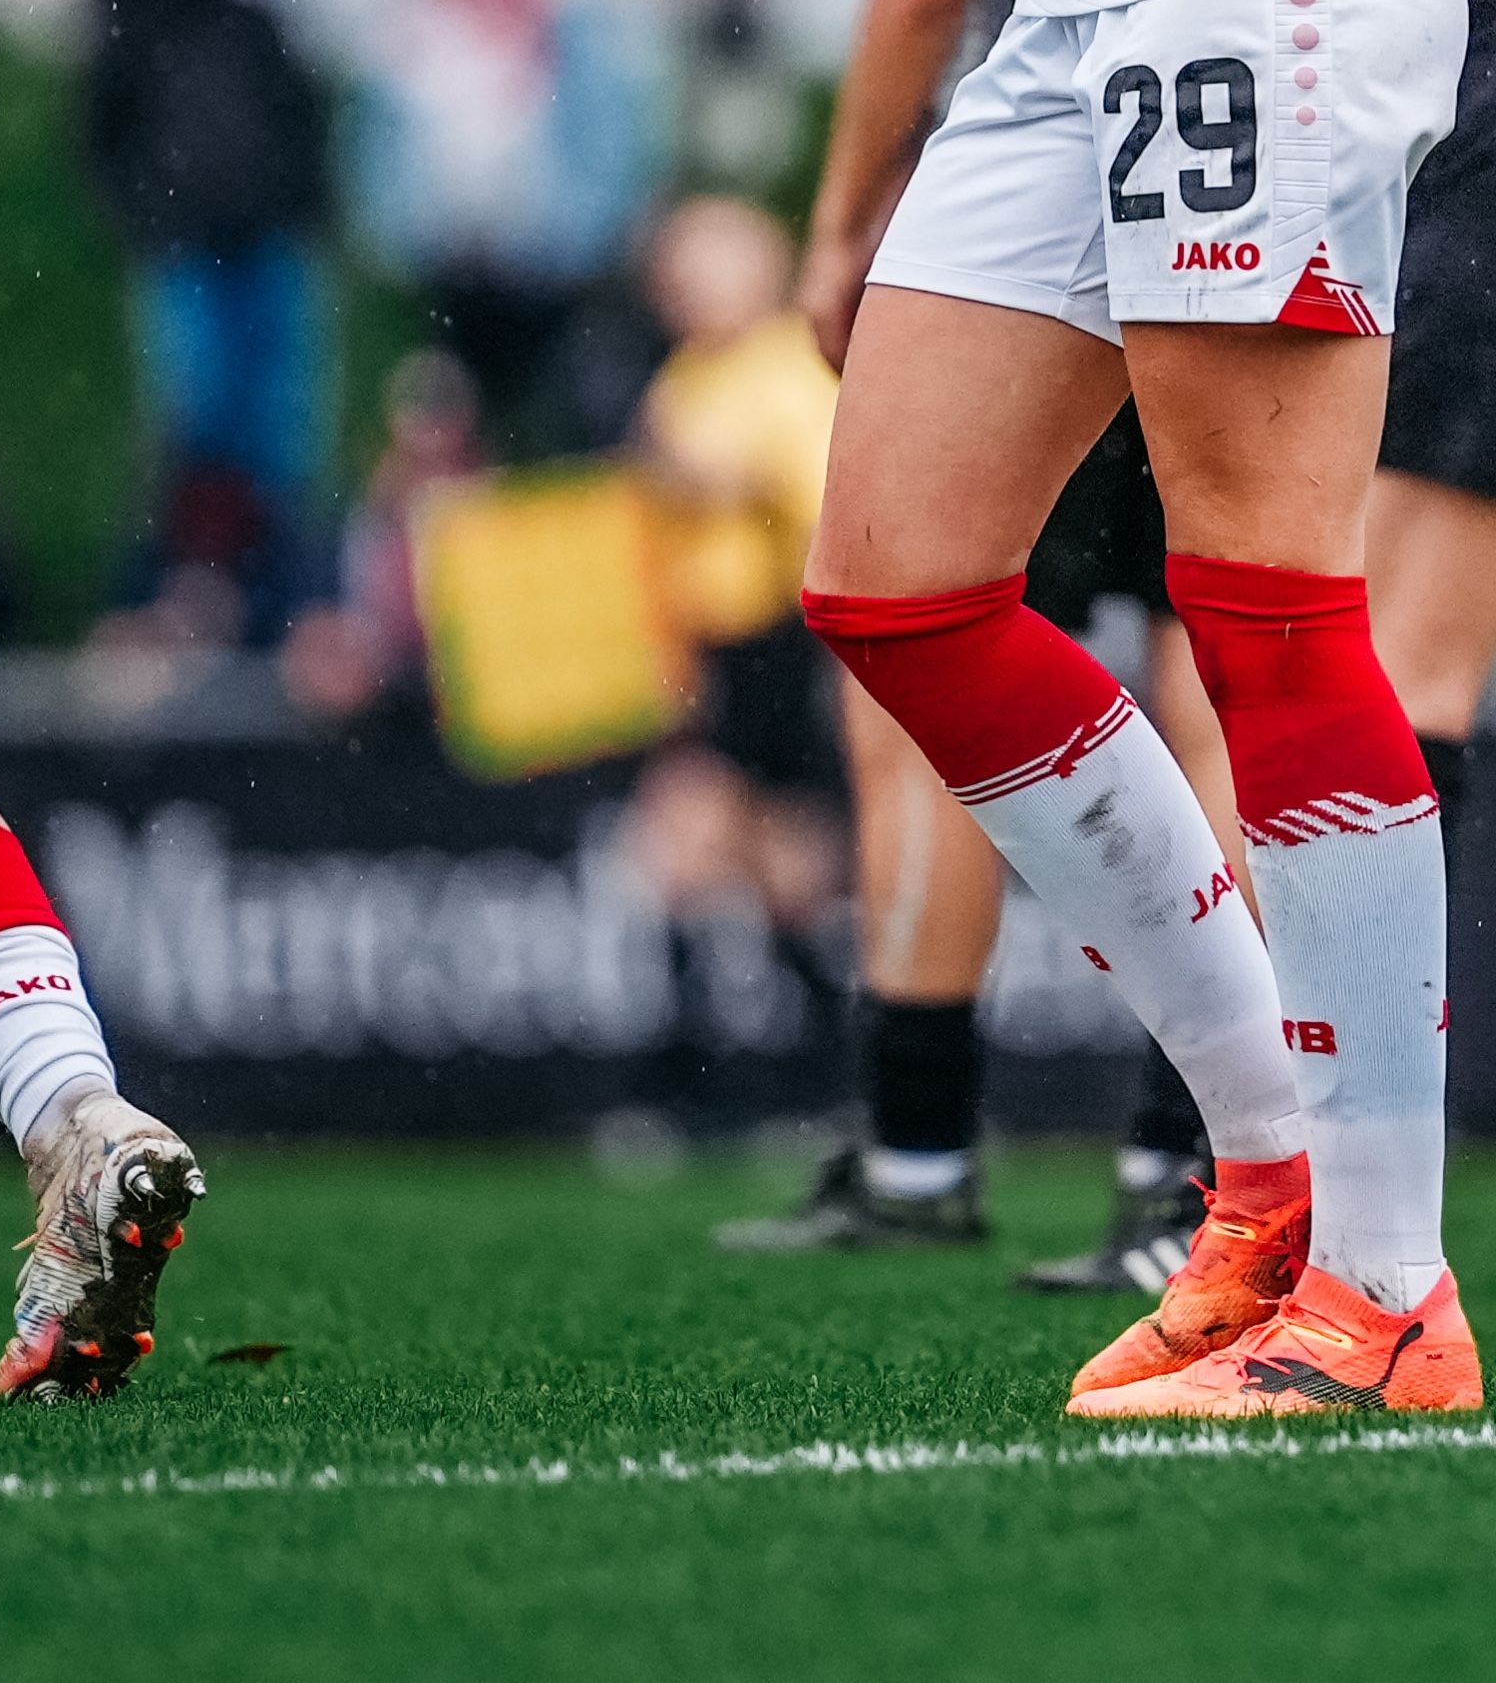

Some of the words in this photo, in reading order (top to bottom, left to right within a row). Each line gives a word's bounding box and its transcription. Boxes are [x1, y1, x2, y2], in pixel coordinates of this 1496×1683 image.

[1103, 57, 1258, 224] 29
[1171, 242, 1261, 271] JAKO
[1190, 862, 1236, 924] JA
